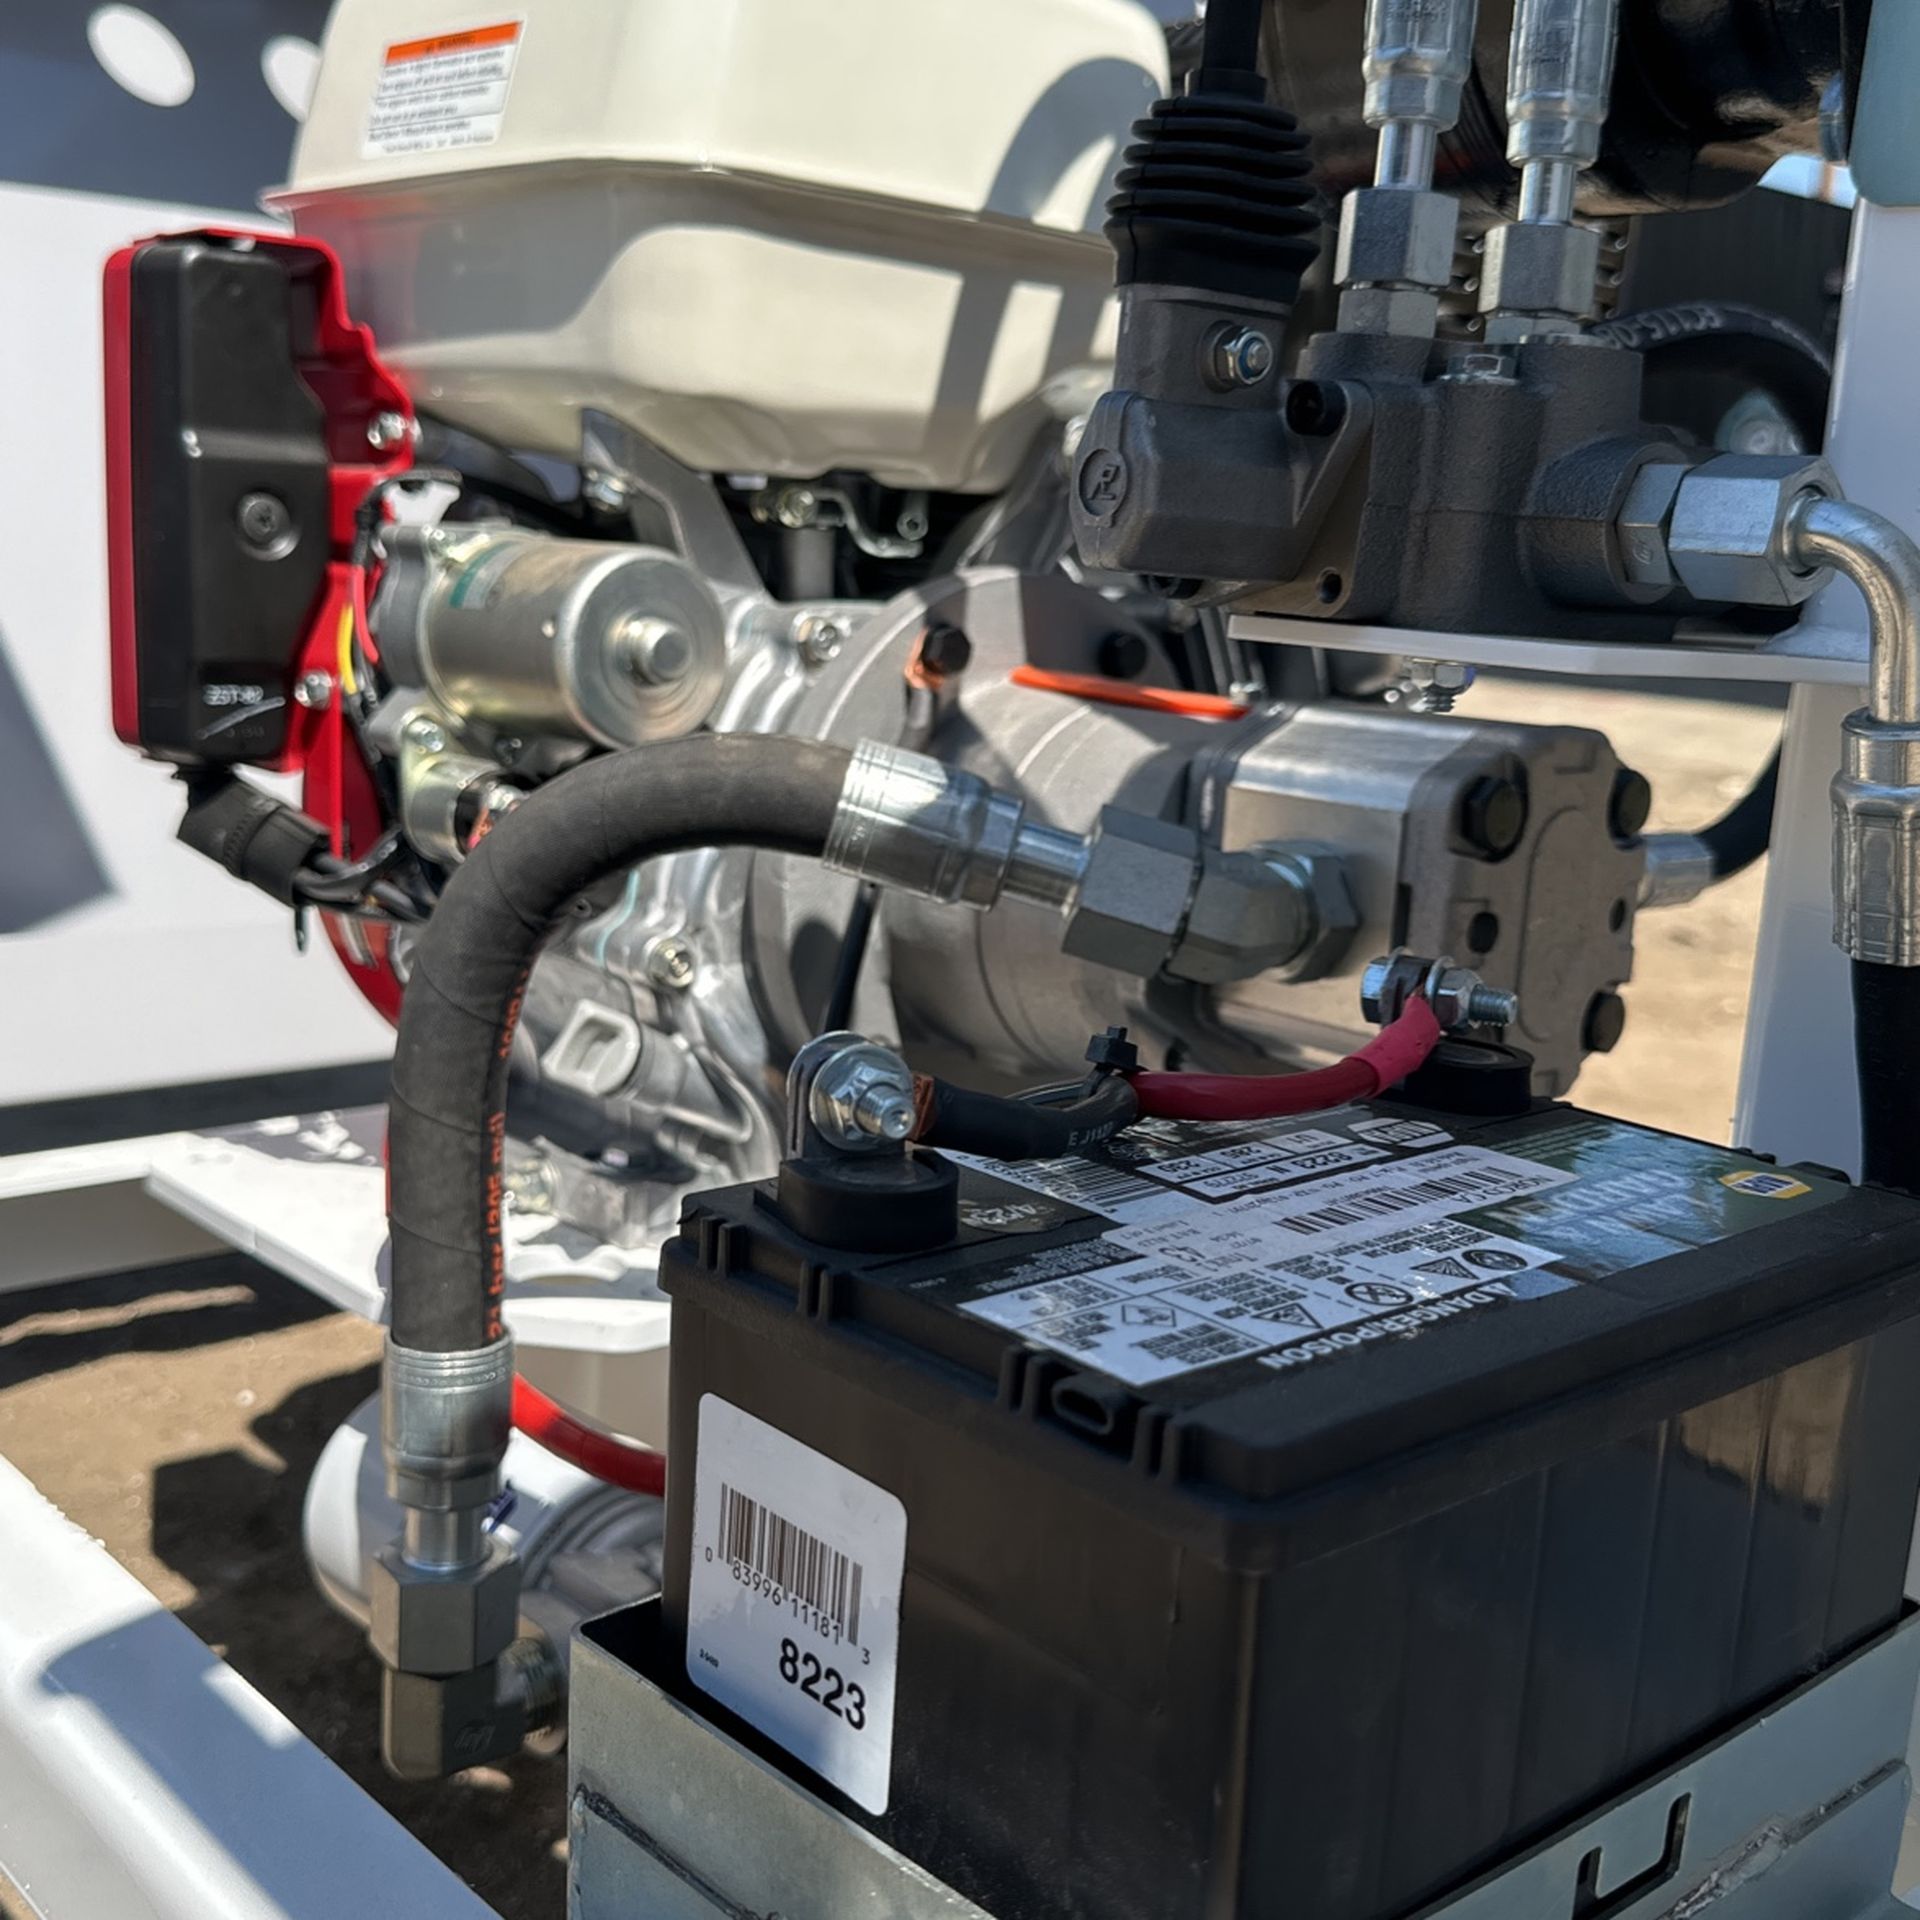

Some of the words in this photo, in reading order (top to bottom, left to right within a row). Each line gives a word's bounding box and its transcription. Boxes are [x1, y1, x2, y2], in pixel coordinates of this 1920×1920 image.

[1291, 1152, 1353, 1169] 8223
[1158, 1246, 1207, 1262] 43
[1254, 1290, 1497, 1368] DANGER/POISON
[704, 1547, 713, 1563] 0
[732, 1558, 782, 1607] 83996
[790, 1597, 842, 1645] 11181
[861, 1646, 871, 1666] 3
[778, 1636, 868, 1732] 8223
